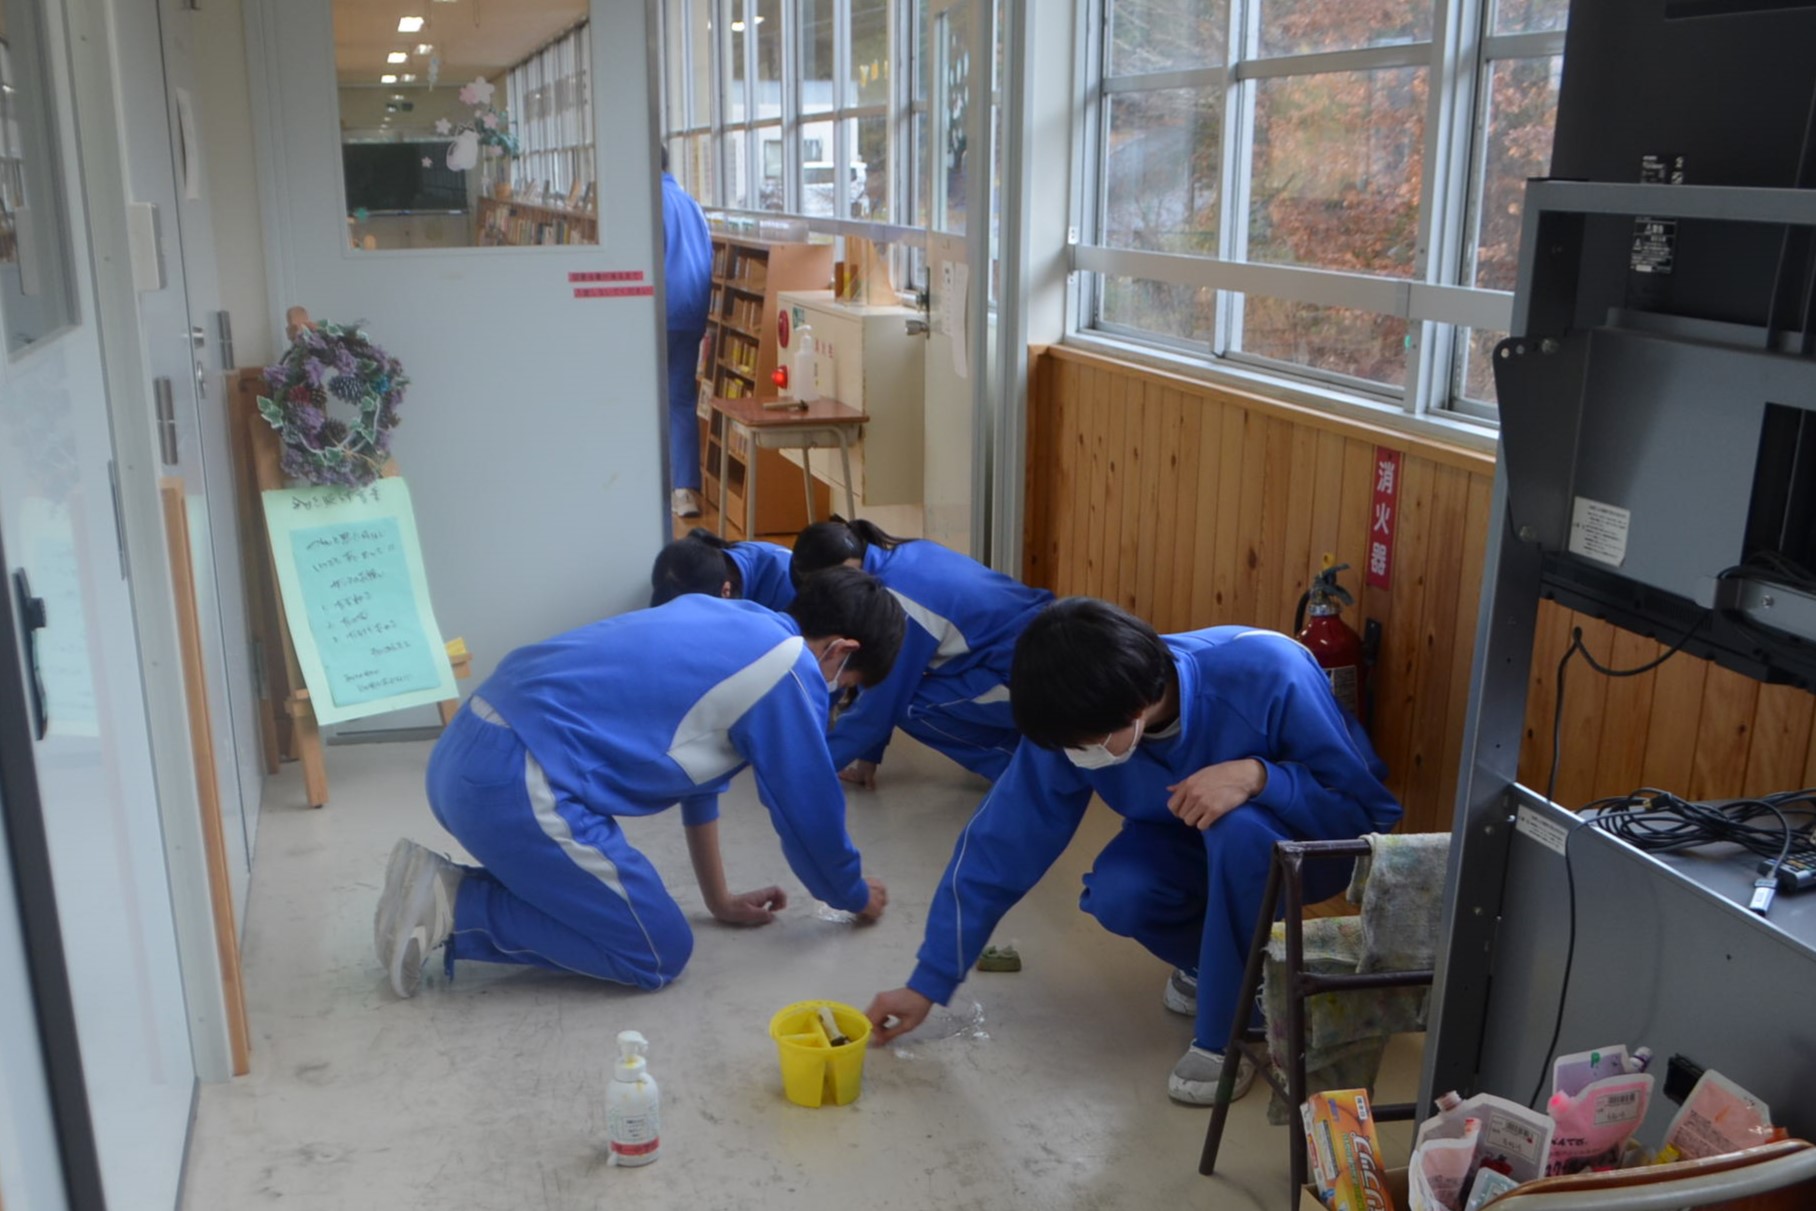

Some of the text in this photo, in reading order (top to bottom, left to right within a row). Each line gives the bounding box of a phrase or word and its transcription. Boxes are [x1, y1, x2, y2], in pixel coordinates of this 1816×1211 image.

[1370, 460, 1396, 577] 消火器
[1350, 1131, 1386, 1211] リラップ
